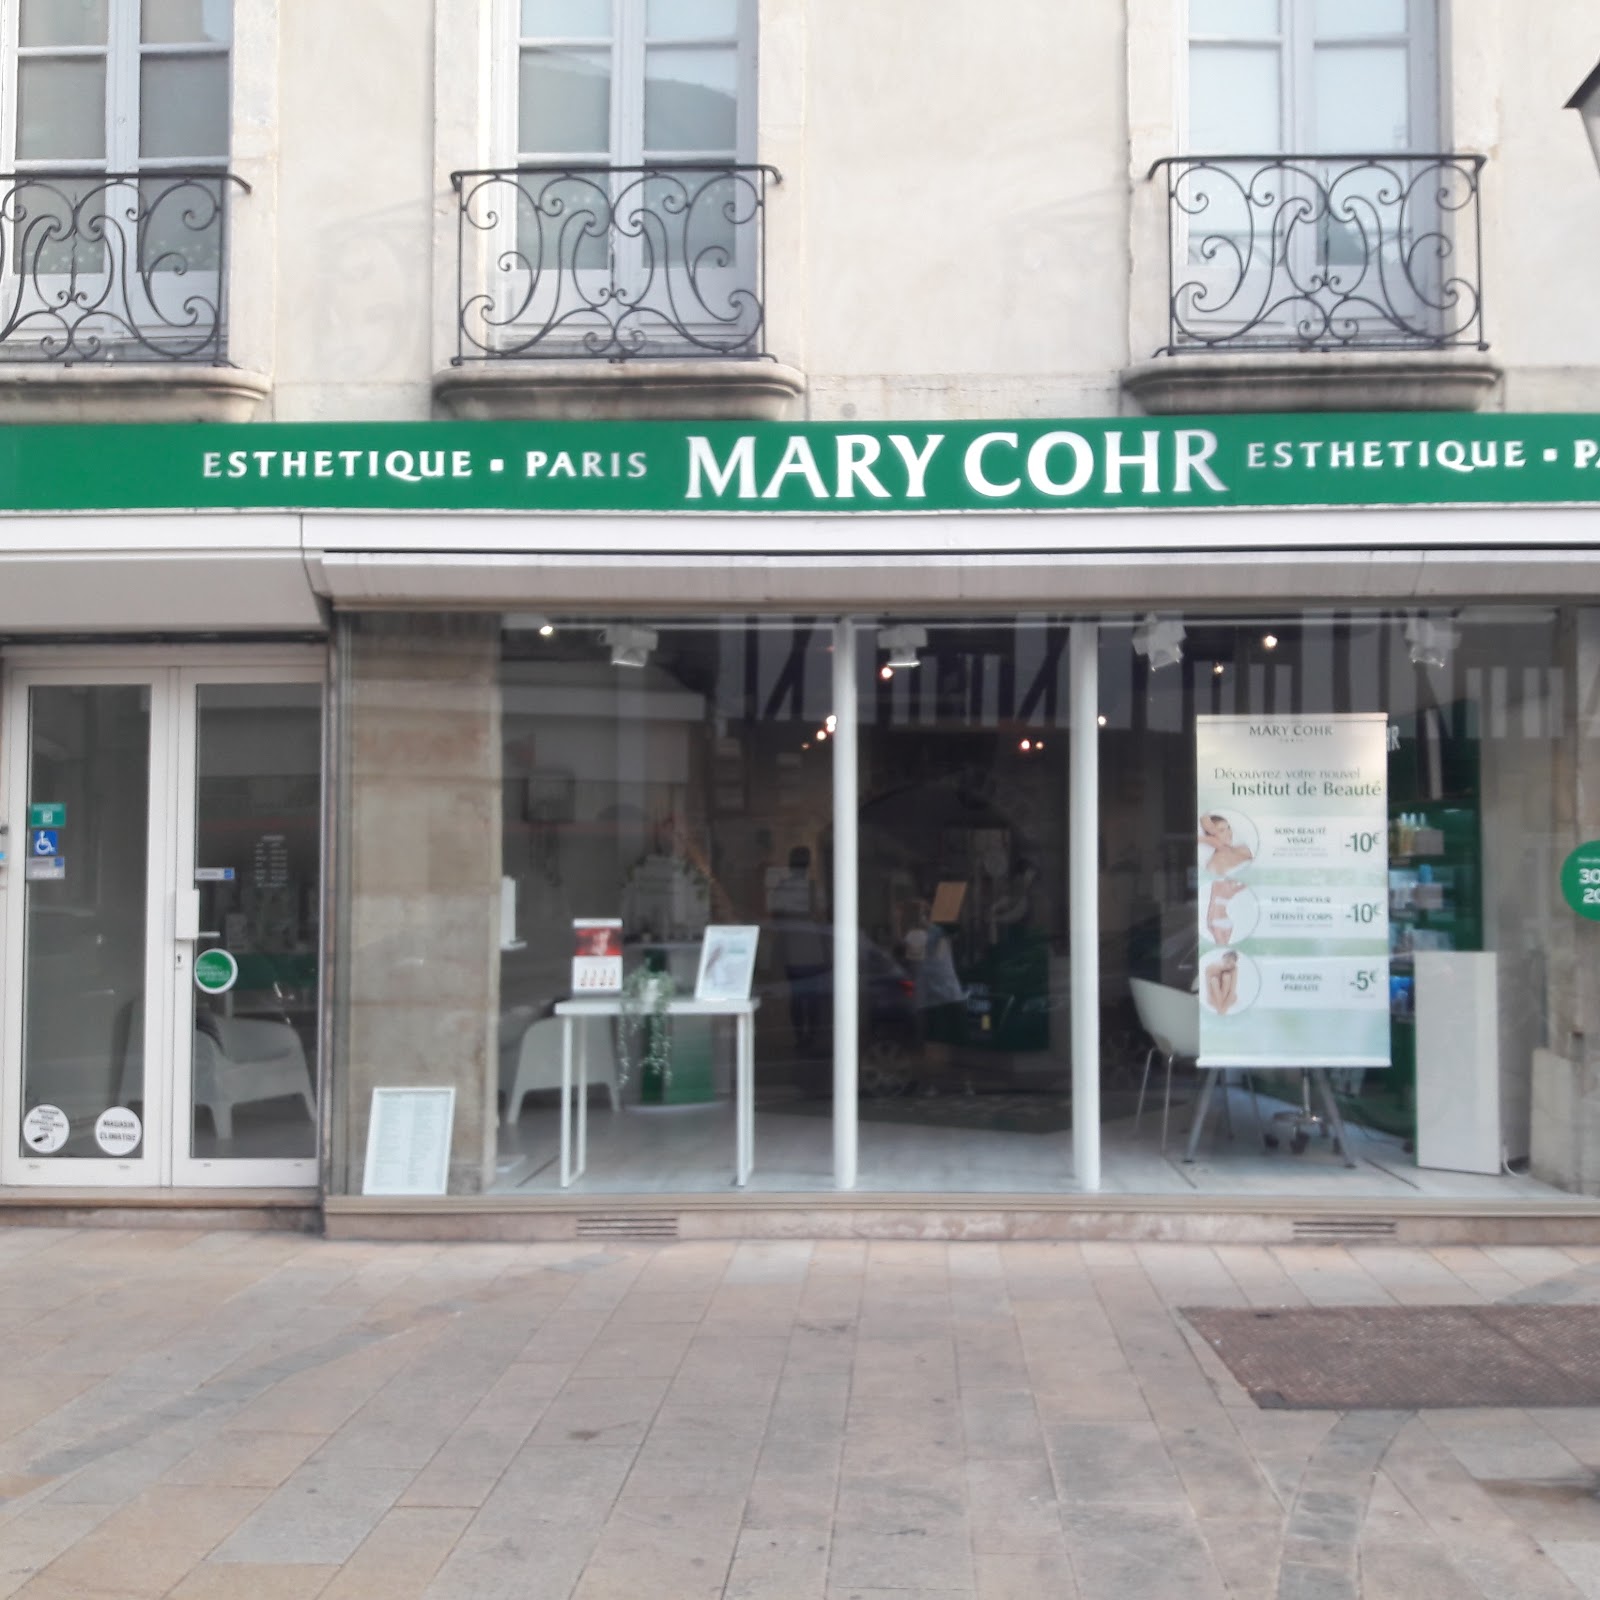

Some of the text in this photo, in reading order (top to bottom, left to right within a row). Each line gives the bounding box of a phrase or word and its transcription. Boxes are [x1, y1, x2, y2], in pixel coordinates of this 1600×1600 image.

[203, 450, 648, 483] ESTHETIQUE PARIS
[685, 429, 1229, 500] MARY COHR
[1247, 438, 1600, 474] ESTHETIQUE P
[1250, 725, 1333, 736] MARY COHR
[1214, 767, 1361, 780] Découvrez votre nouvel
[1231, 781, 1382, 797] Institut de Beauté
